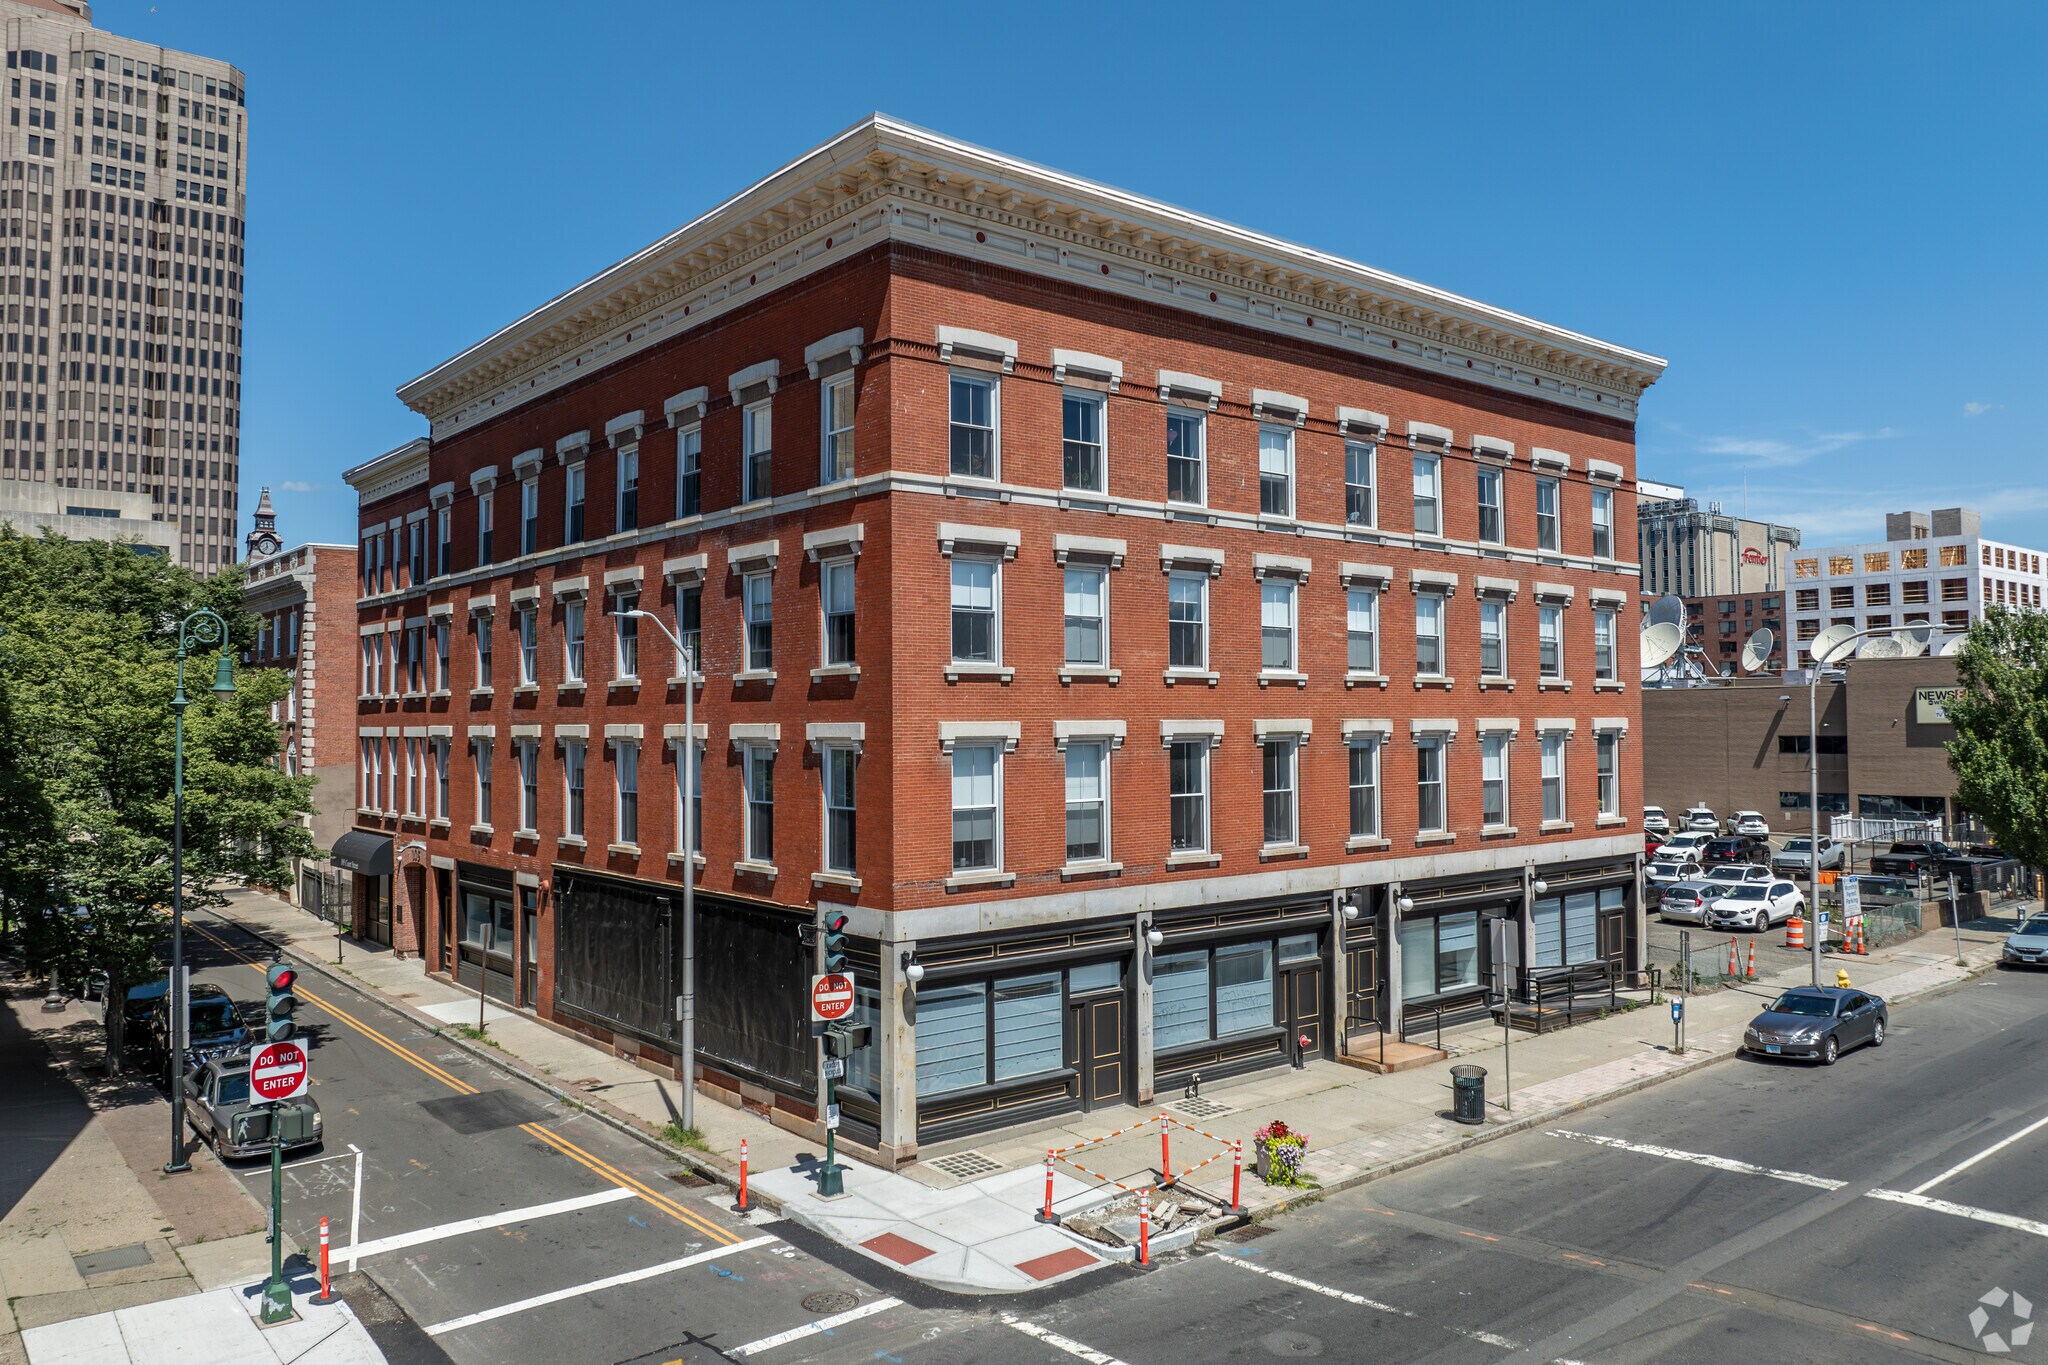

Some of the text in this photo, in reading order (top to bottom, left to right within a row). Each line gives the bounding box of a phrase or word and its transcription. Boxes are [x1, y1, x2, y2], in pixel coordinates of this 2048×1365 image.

[819, 982, 848, 992] DO NOT
[821, 1002, 845, 1011] ENTER
[260, 1050, 299, 1066] DO NOT
[263, 1076, 295, 1090] ENTER
